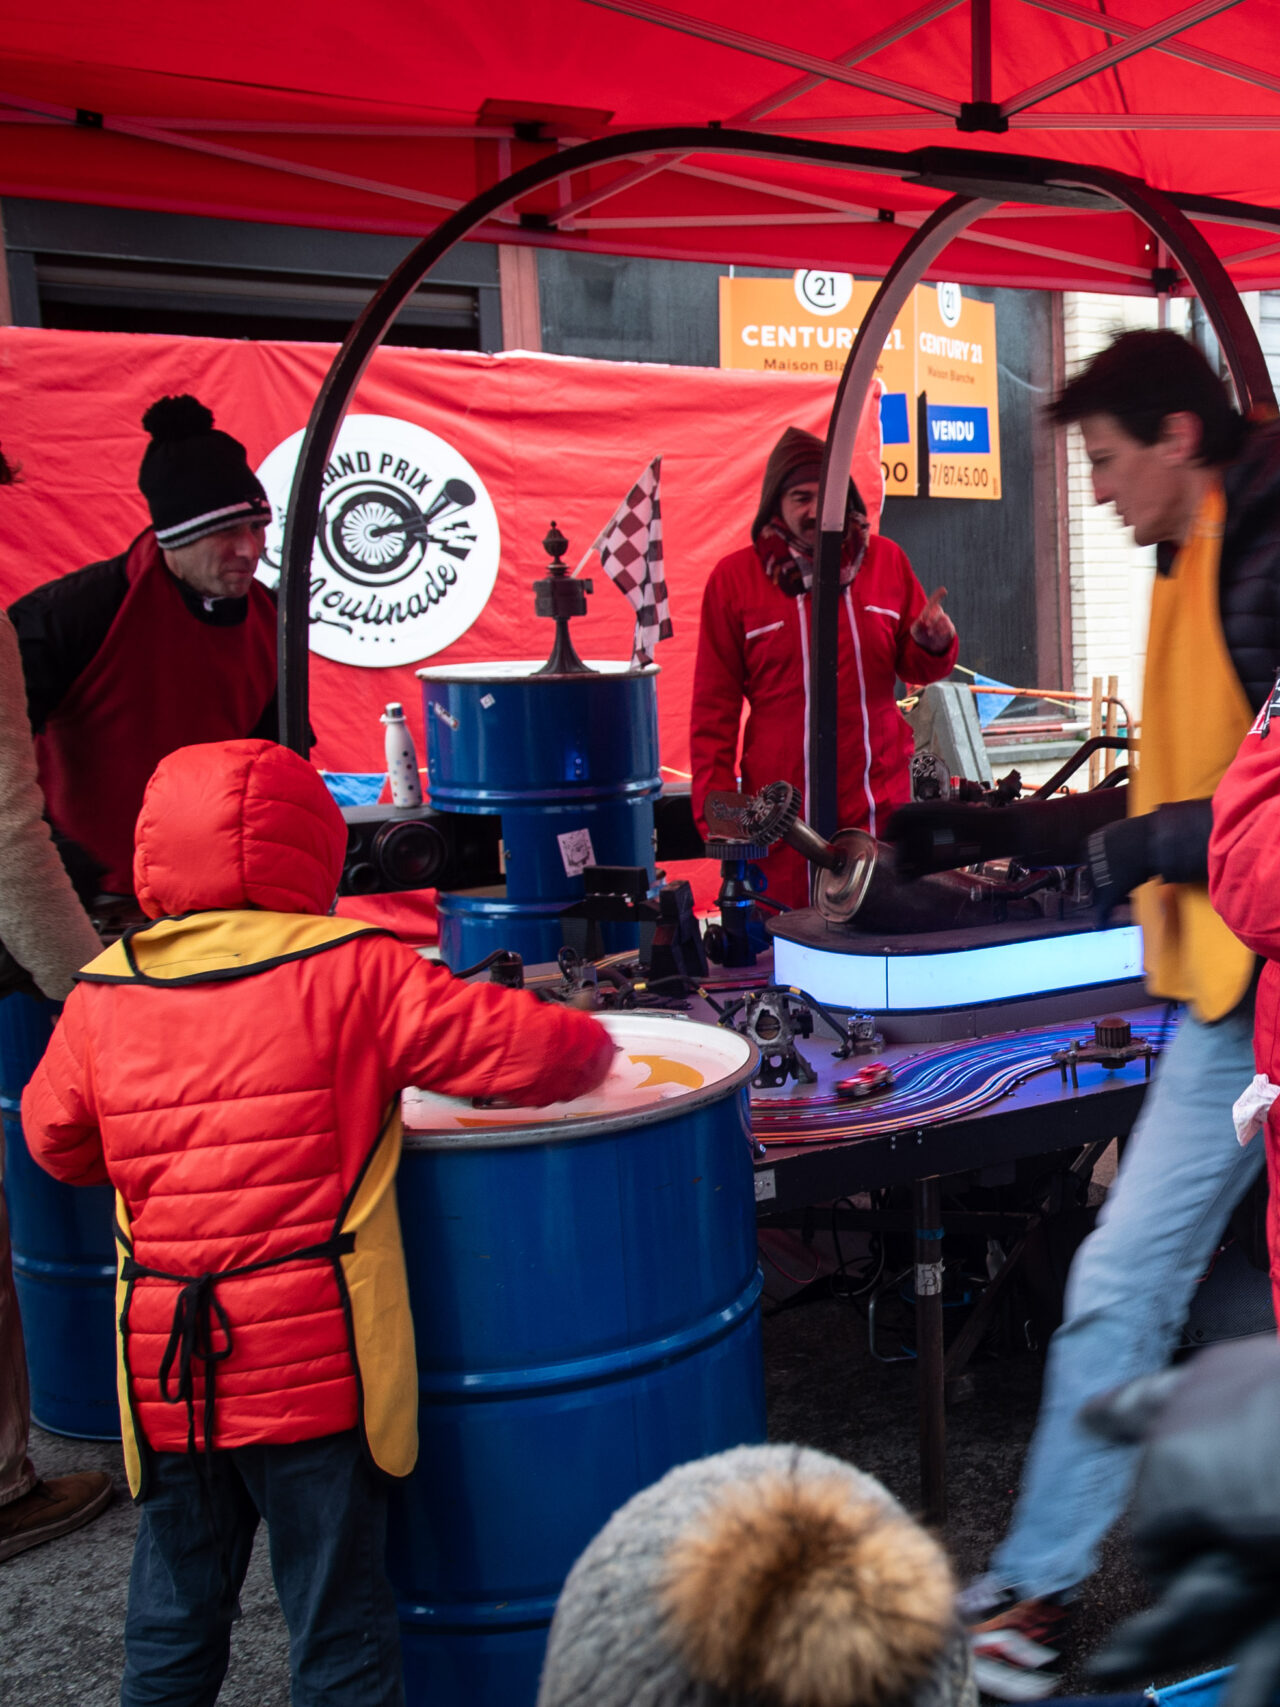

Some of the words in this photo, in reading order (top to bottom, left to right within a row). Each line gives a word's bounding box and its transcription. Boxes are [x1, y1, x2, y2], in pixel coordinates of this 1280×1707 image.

[815, 277, 835, 296] 21
[919, 331, 970, 361] CENTURY
[970, 343, 983, 364] 21
[763, 358, 819, 371] Maison
[932, 420, 974, 441] VENDU
[322, 451, 371, 487] AND
[379, 452, 432, 495] PRIX
